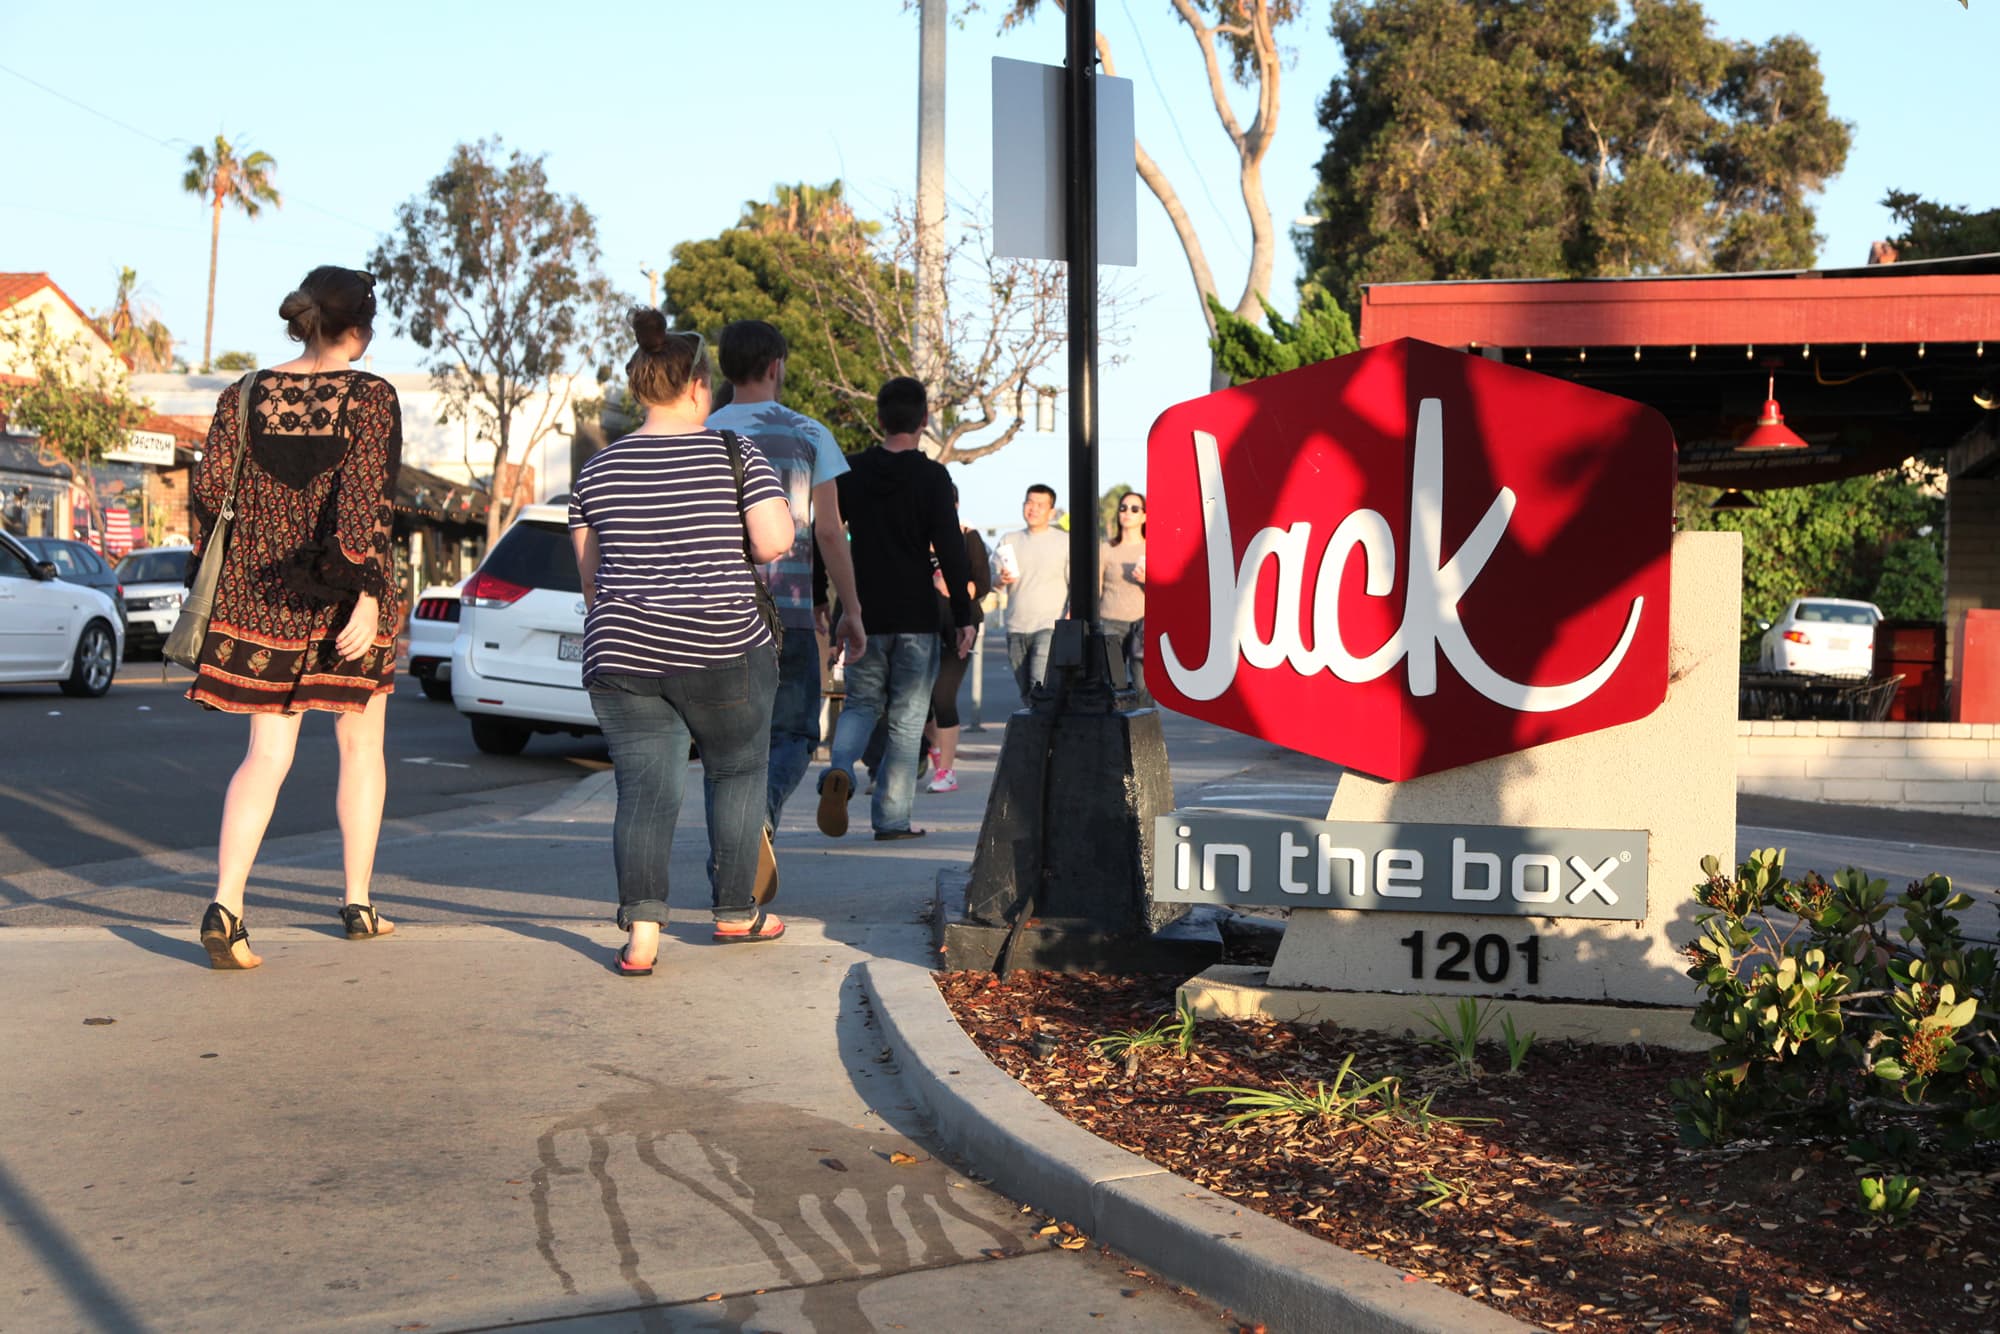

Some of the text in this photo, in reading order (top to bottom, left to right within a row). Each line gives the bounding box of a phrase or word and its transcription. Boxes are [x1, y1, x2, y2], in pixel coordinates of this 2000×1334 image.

[1159, 397, 1644, 712] Jack
[1174, 825, 1251, 892] in
[1279, 831, 1424, 898] the
[1400, 930, 1540, 984] 1201
